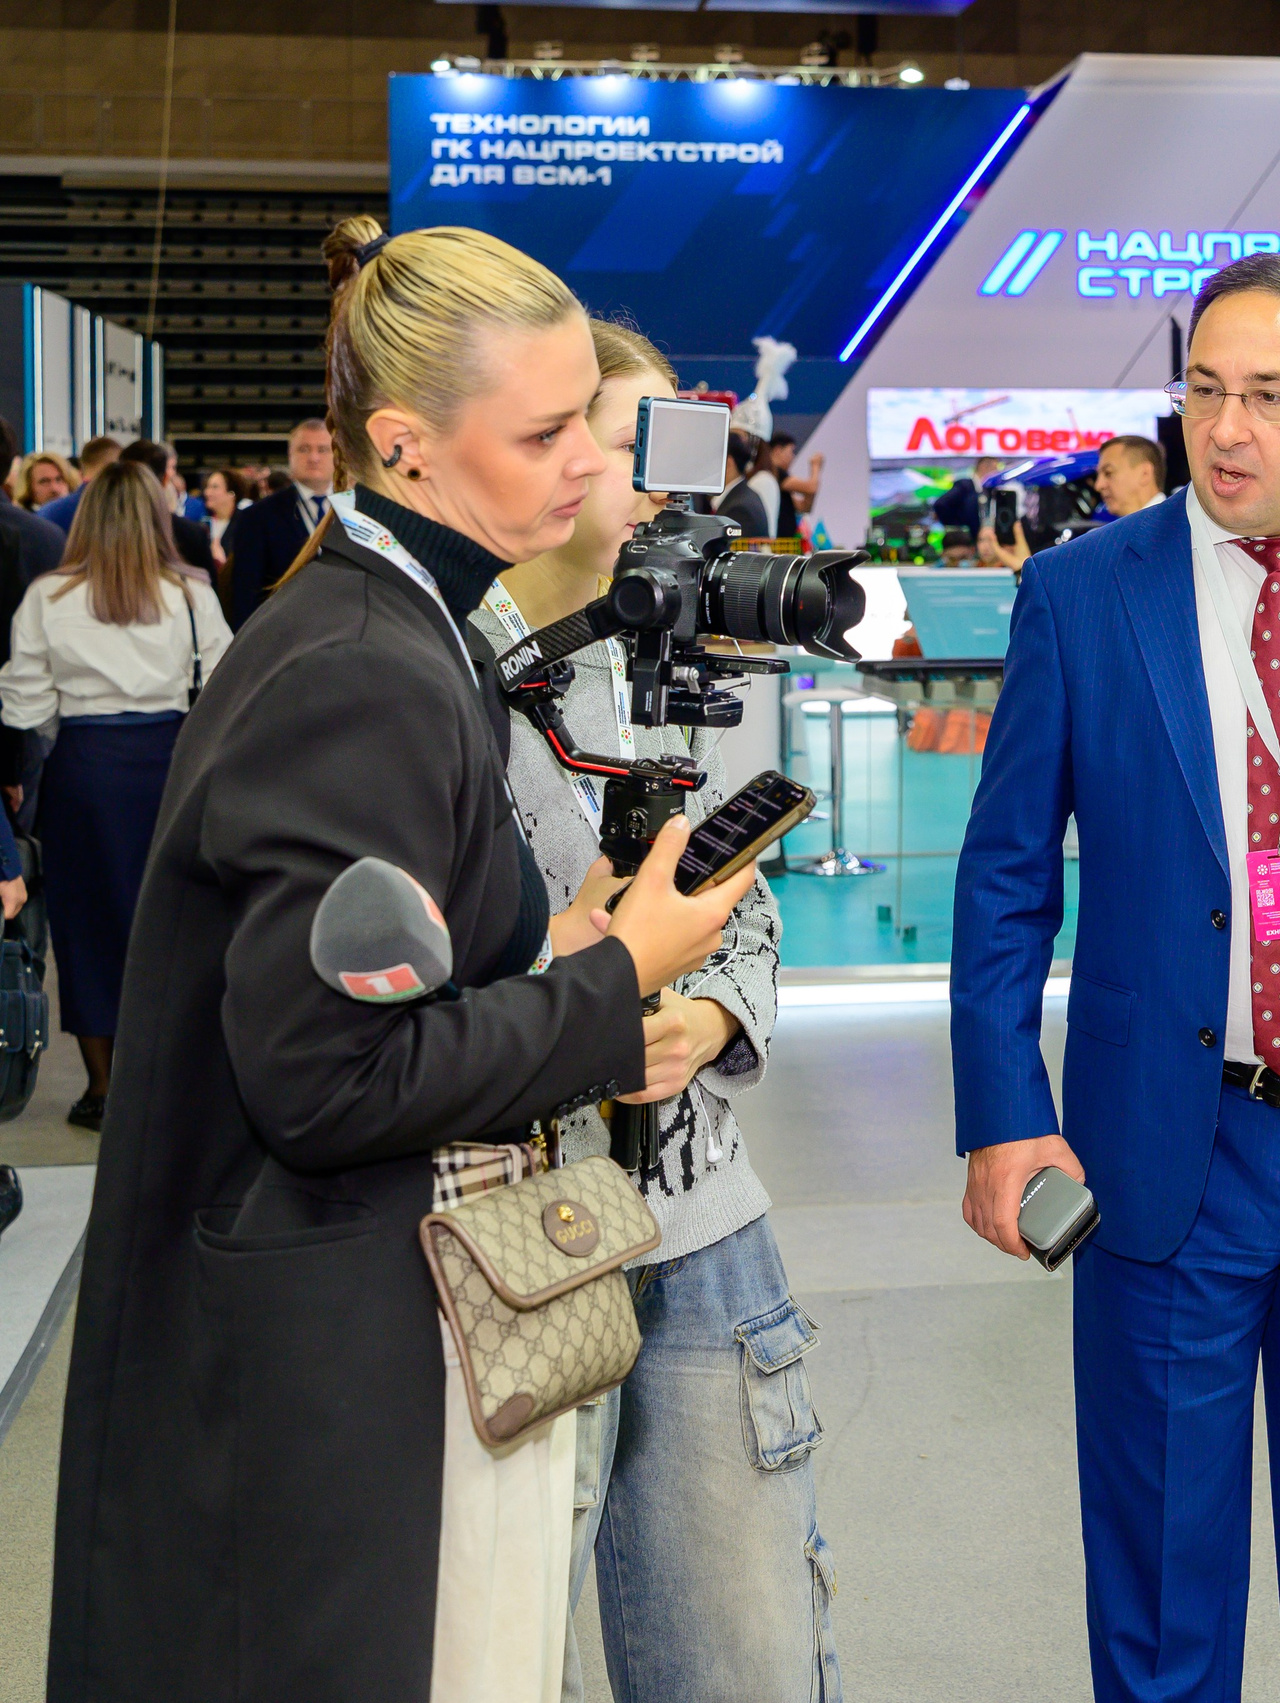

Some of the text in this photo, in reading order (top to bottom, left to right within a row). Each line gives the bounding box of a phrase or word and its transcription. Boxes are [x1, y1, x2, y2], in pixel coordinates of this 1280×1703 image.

[429, 113, 650, 137] ТЕХНОЛОГИИ
[431, 138, 784, 164] ГК НАЦПРОЕКТСТРОЙ
[430, 163, 612, 187] ДЛЯ ВСМ-1
[500, 640, 543, 681] RONIN
[365, 974, 395, 995] 1
[555, 1219, 596, 1244] GUCCI
